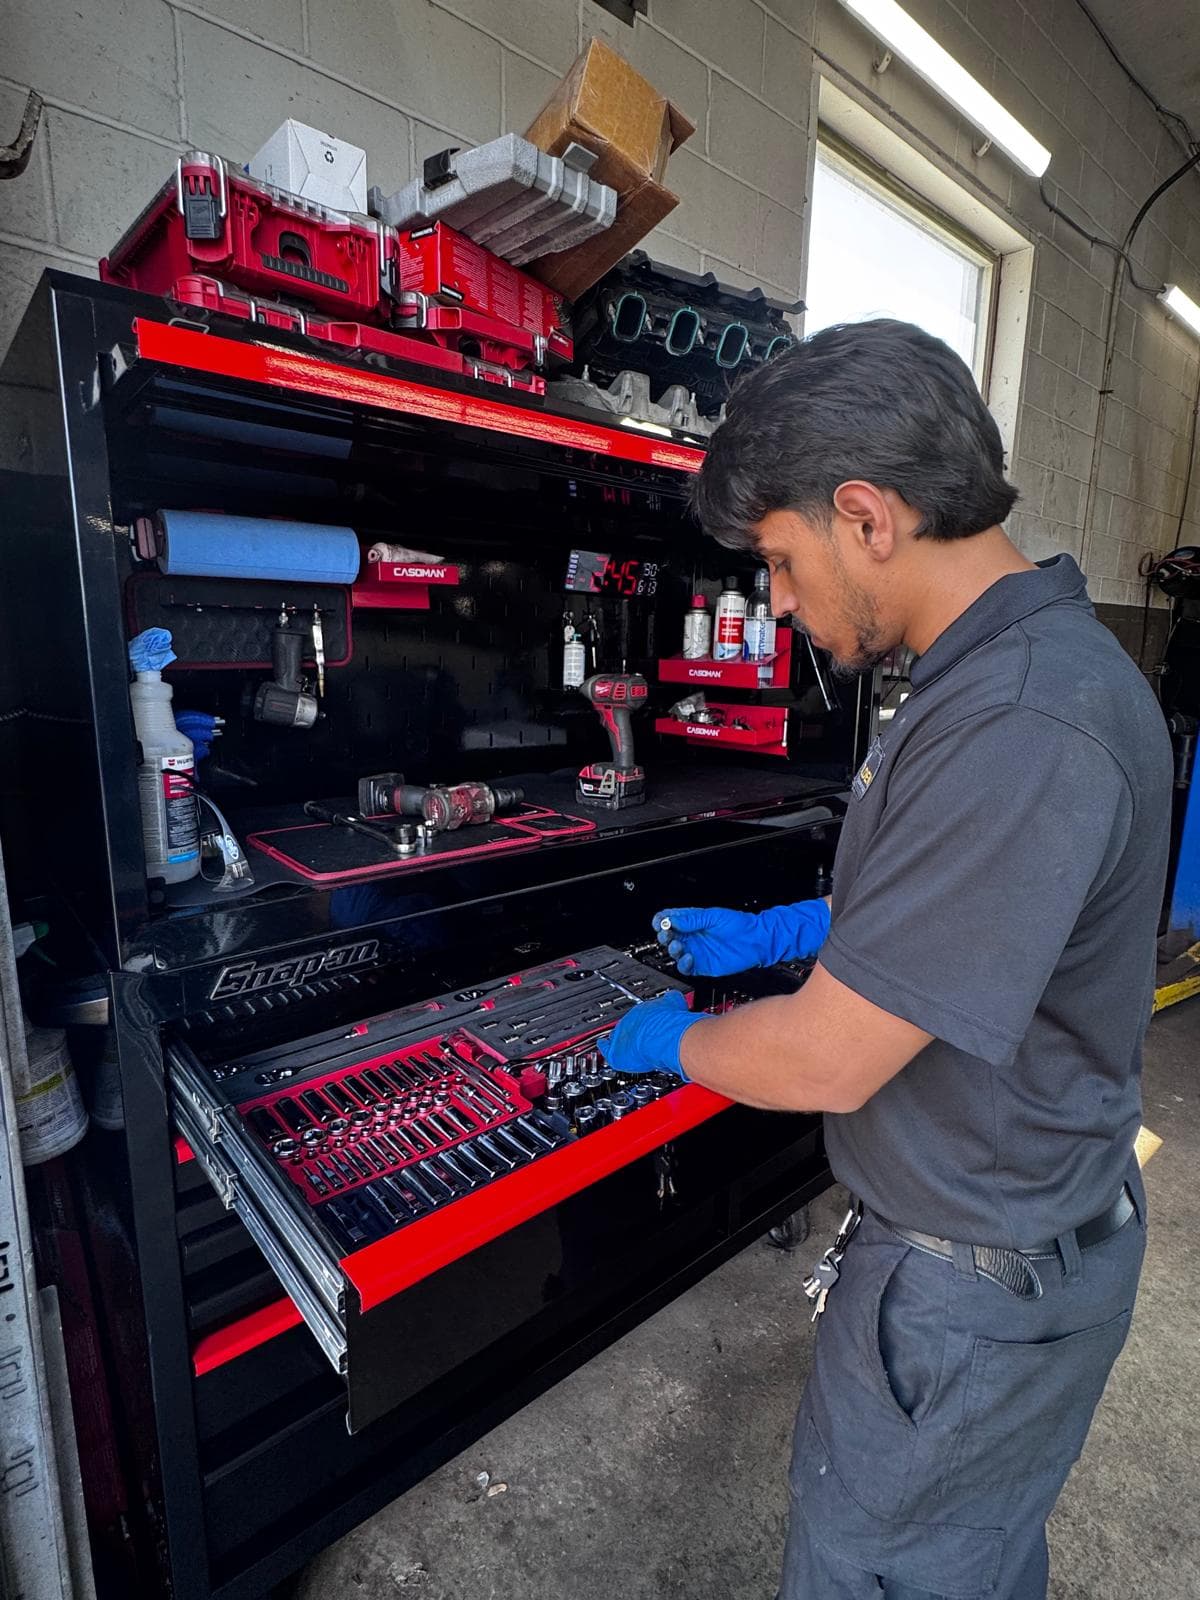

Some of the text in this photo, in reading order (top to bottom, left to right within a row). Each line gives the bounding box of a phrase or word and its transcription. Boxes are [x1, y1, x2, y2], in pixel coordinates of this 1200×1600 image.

[393, 567, 445, 579] CASOMAN
[588, 555, 639, 596] 2:45
[688, 668, 722, 679] CASOMAN
[686, 725, 719, 737] CASOMAN
